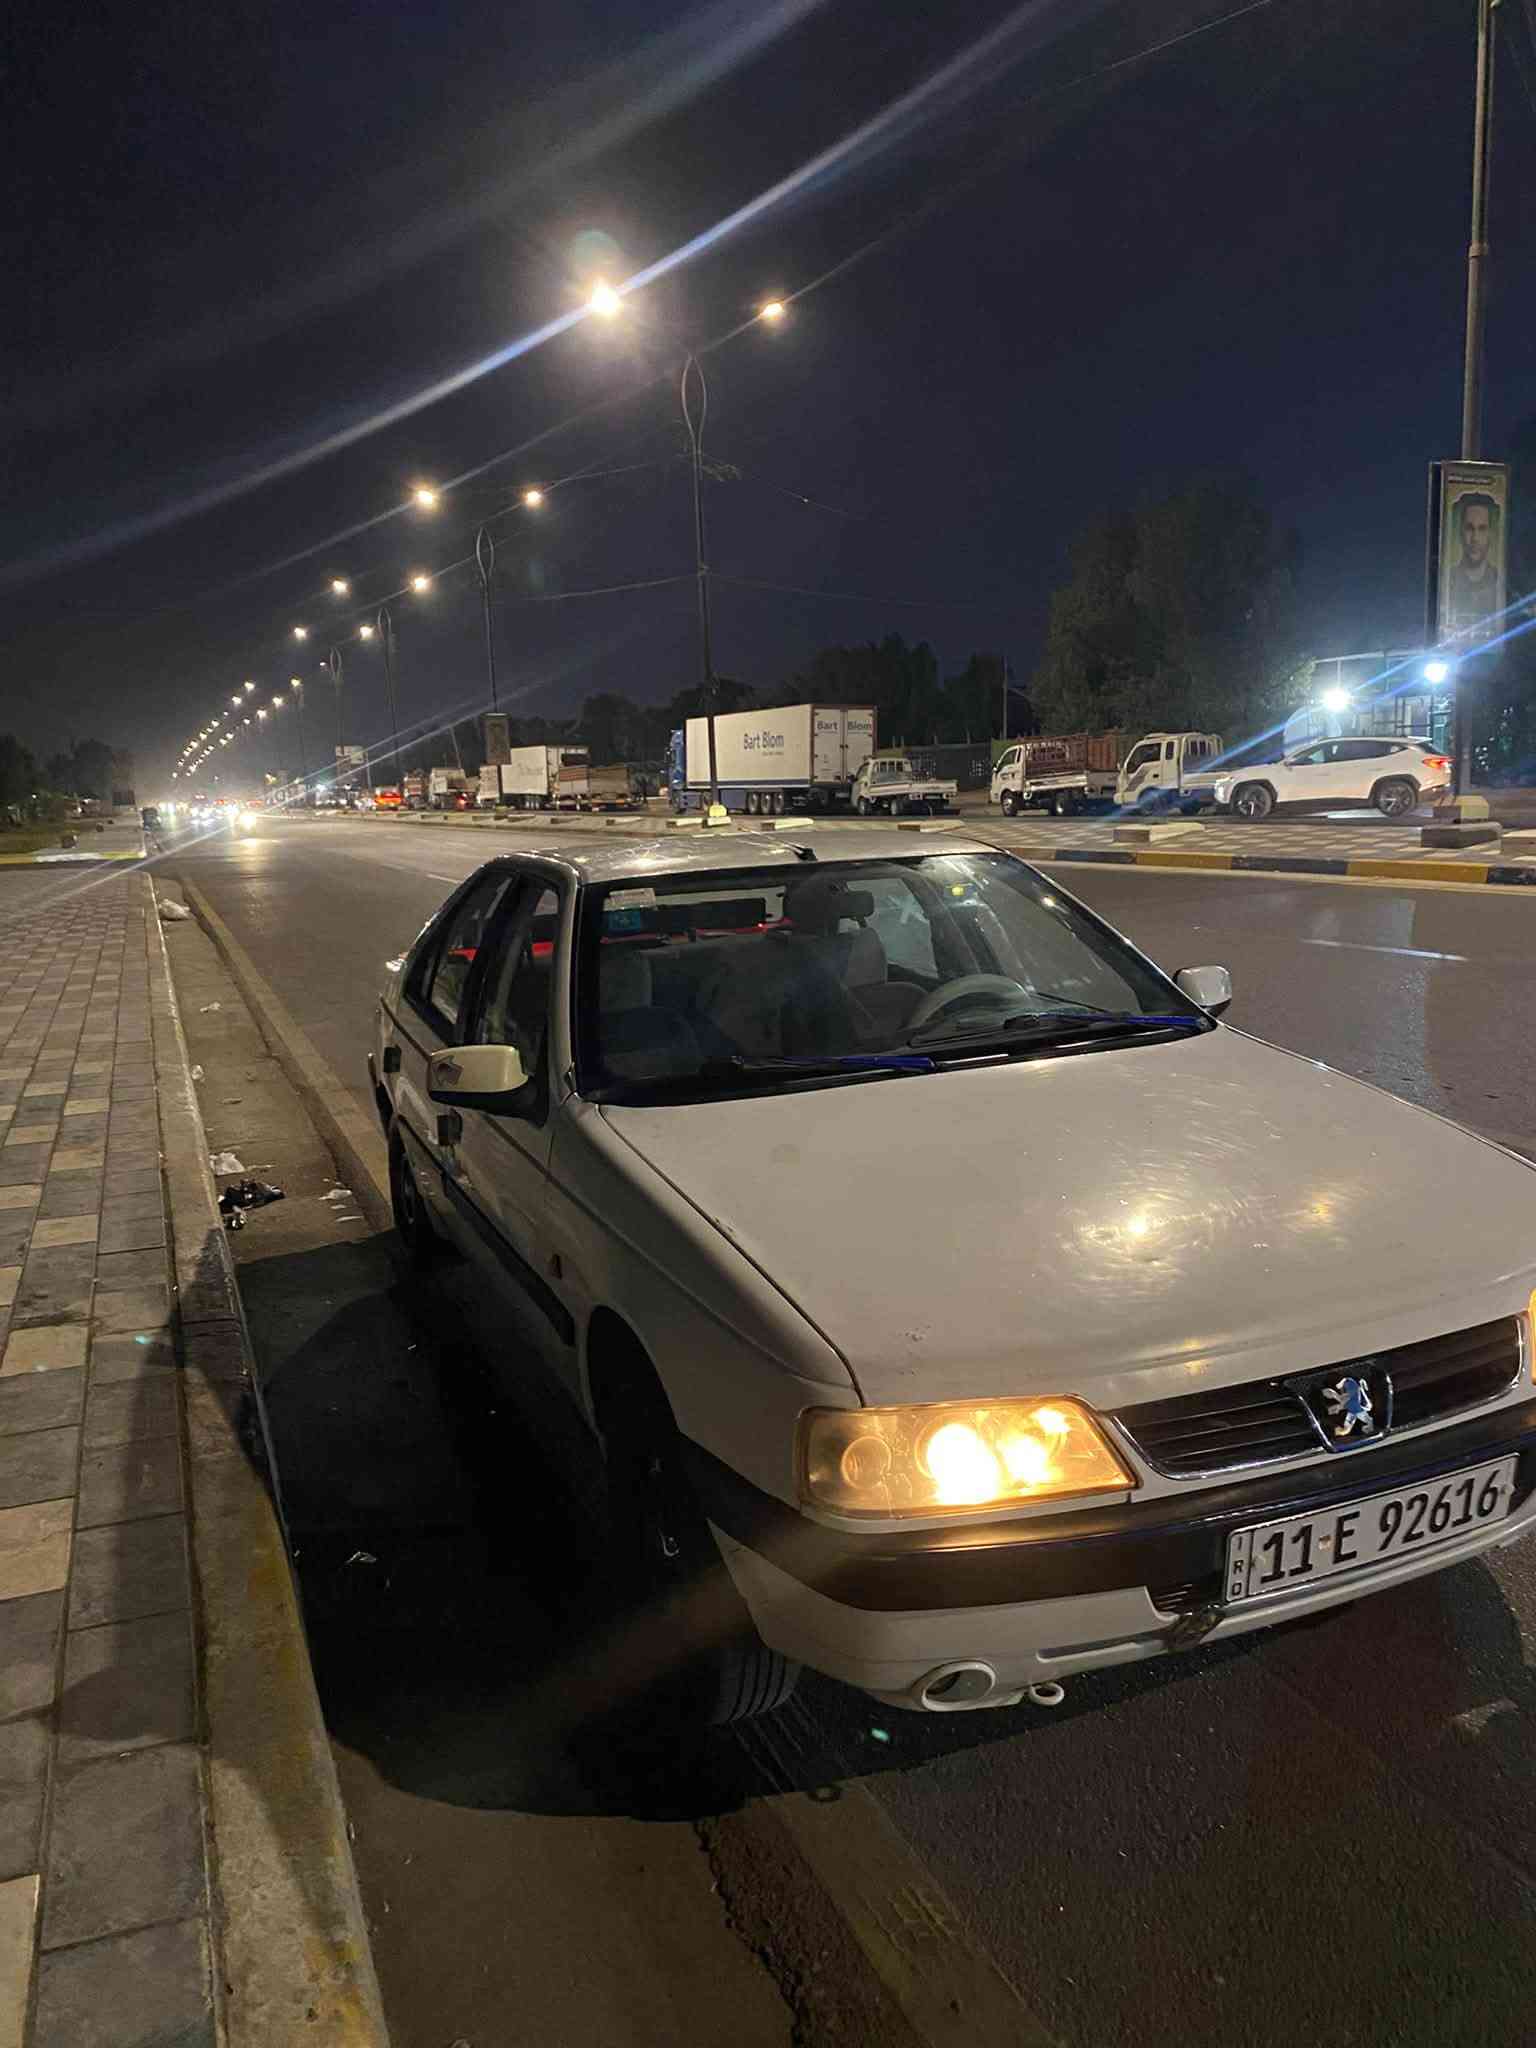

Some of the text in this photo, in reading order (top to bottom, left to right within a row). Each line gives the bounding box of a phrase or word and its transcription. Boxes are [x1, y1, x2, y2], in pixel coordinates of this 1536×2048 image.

[817, 720, 872, 730] Bart Blom
[743, 731, 784, 750] Bart Blom
[1260, 1469, 1500, 1584] 11 E 92616
